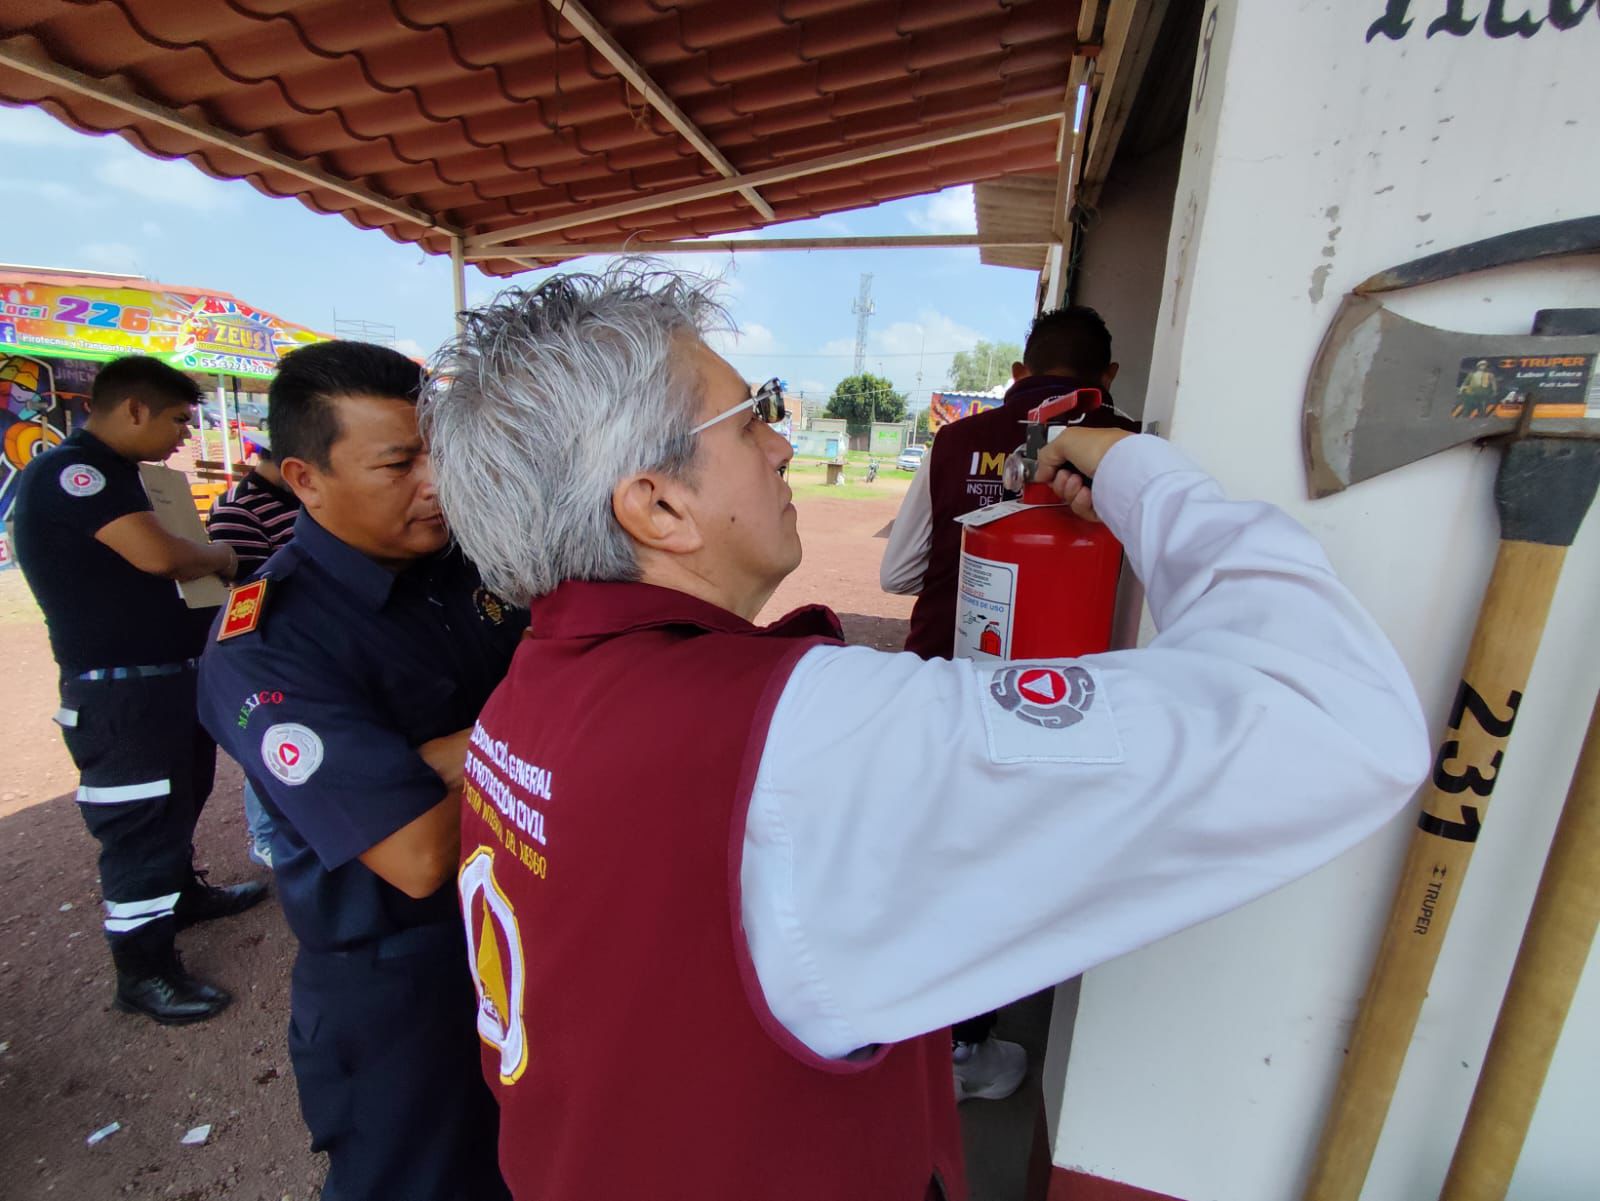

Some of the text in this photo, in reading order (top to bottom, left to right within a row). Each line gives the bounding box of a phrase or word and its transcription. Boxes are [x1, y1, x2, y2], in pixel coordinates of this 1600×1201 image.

[54, 295, 152, 333] 226
[1520, 356, 1586, 368] TRUPER
[969, 451, 1005, 475] IM
[237, 690, 284, 729] MEXICO
[508, 753, 552, 800] GENERAL
[1417, 678, 1523, 843] 231
[516, 799, 547, 846] CIVIL
[1413, 881, 1443, 936] TRUPER
